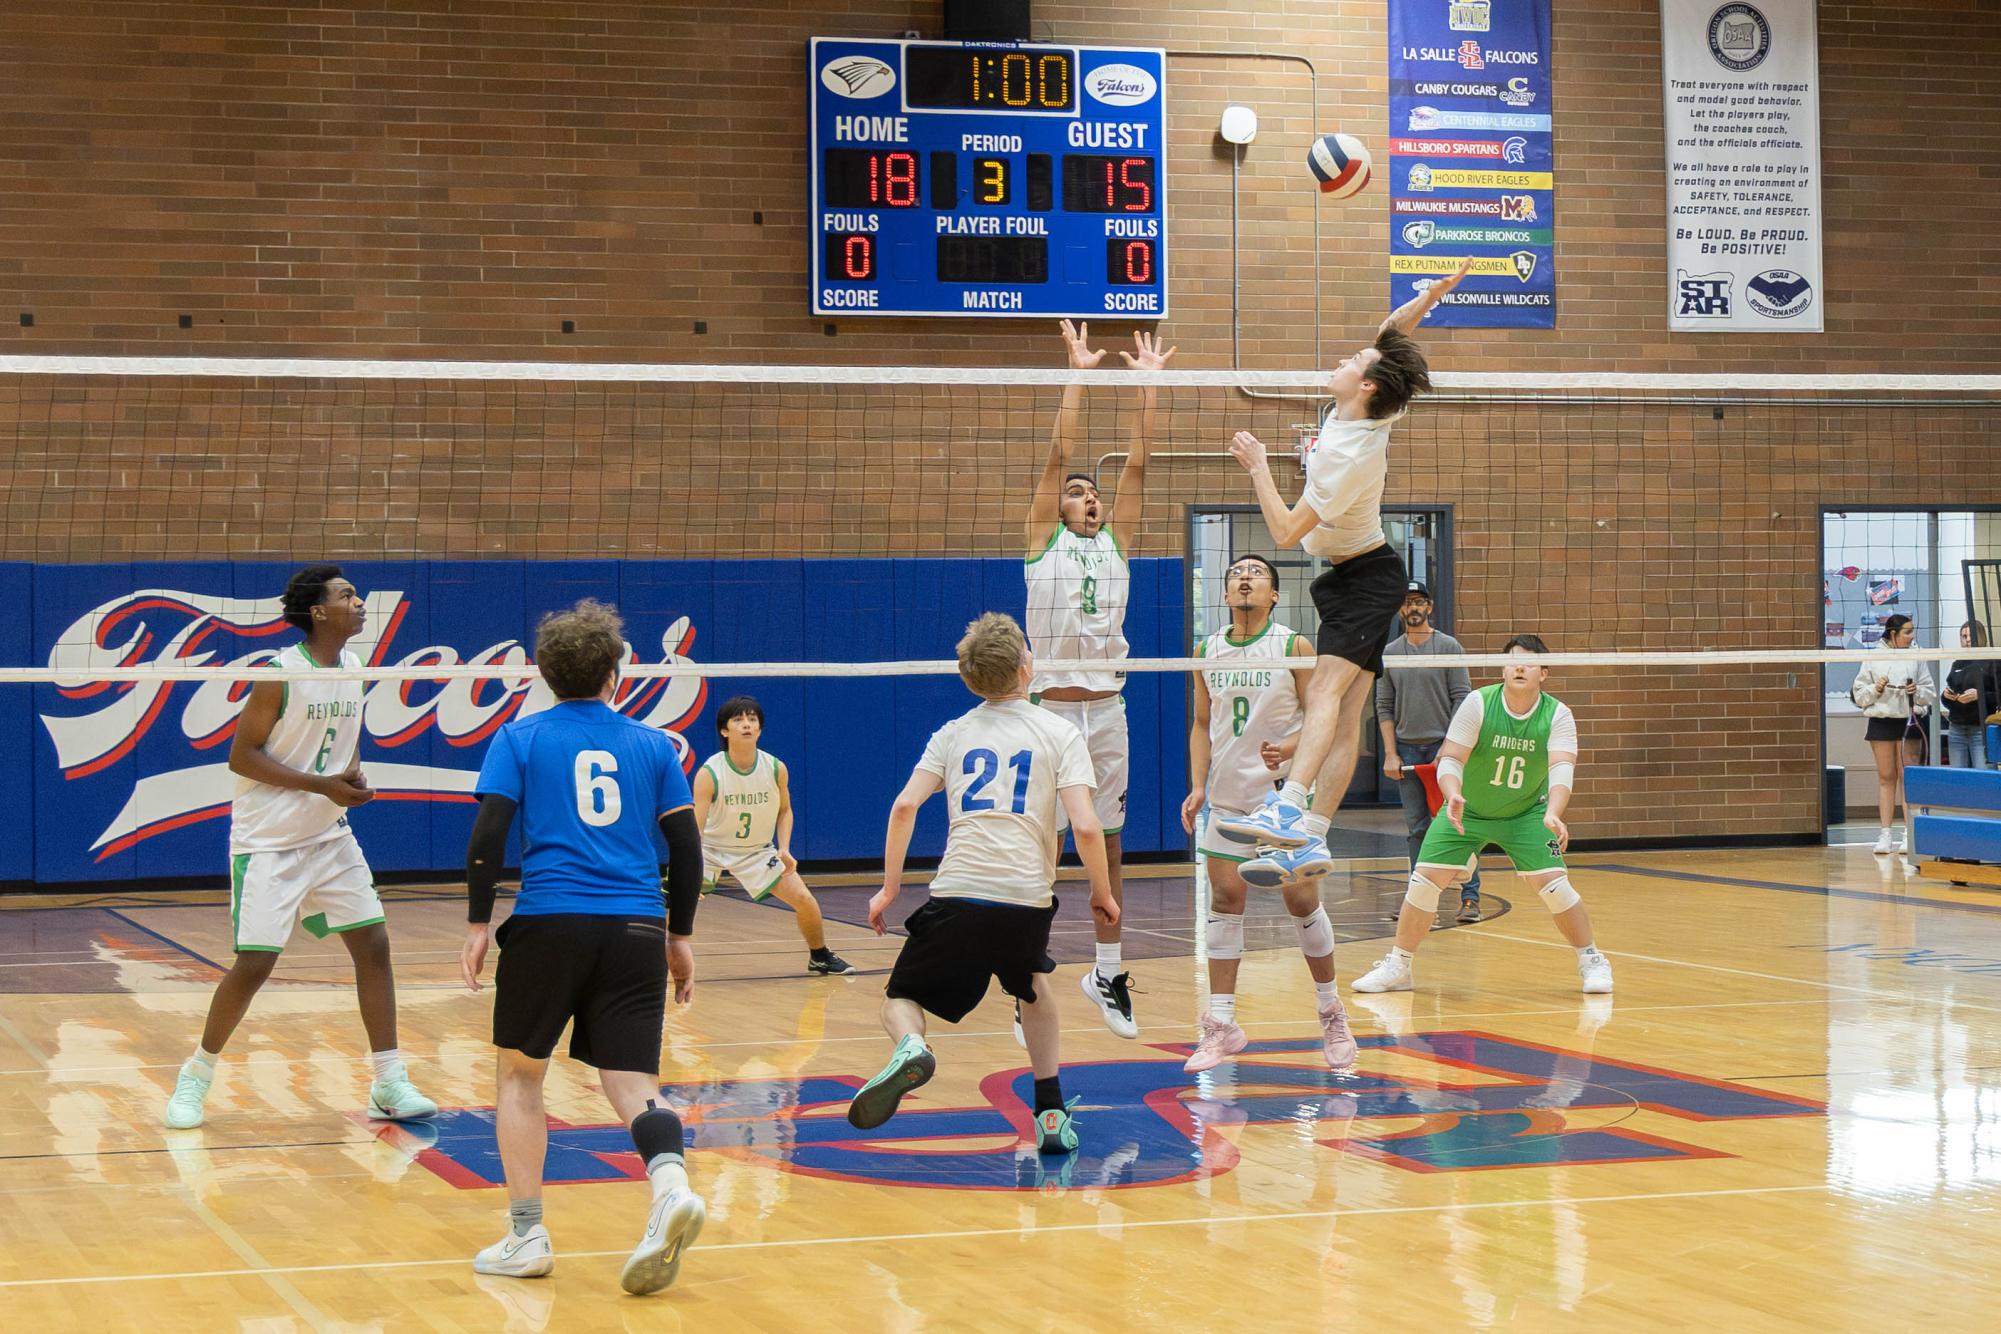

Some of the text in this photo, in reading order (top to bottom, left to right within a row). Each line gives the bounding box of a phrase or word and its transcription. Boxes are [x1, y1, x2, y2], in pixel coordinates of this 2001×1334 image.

[964, 41, 1017, 49] DAKTRONICS
[1403, 47, 1455, 61] LA SALLE
[1486, 50, 1538, 64] FALCONS
[972, 54, 1068, 106] 1:00
[1097, 78, 1145, 93] Falcons
[1671, 80, 1808, 93] Treat everyone with respect
[1415, 83, 1497, 96] CANBY COUGARS
[1677, 95, 1802, 105] and model good behavior.
[1443, 115, 1498, 126] CENTENNIAL
[1501, 117, 1536, 127] EAGLES
[1690, 110, 1705, 118] Let
[1709, 110, 1724, 118] the
[1728, 111, 1764, 120] players
[836, 116, 908, 142] HOME
[1068, 122, 1148, 148] GUEST
[1694, 124, 1787, 134] the coaches coach,
[962, 135, 1022, 152] PERIOD
[1399, 142, 1499, 154] HILLSBORO SPARTANS
[1678, 138, 1803, 148] and the officials officiate.
[1673, 163, 1687, 171] We
[1691, 163, 1703, 171] all
[1742, 164, 1760, 172] role
[1777, 165, 1797, 174] play
[1800, 165, 1808, 173] in
[871, 154, 915, 206] 18
[983, 162, 1003, 201] 3
[1106, 160, 1149, 210] 15
[1468, 176, 1493, 184] RIVER
[1497, 176, 1529, 185] EAGLES
[1675, 177, 1715, 187] creating
[1734, 178, 1795, 187] environment
[1798, 179, 1808, 187] of
[1691, 192, 1793, 202] SAFETY, TOLERANCE,
[1396, 202, 1499, 213] MILWAUKIE MUSTANGS
[1502, 196, 1522, 220] M
[1673, 206, 1810, 216] ACCEPTANCE, and RESPECT.
[824, 214, 879, 232] FOULS
[937, 217, 1048, 235] PLAYER FOUL
[1105, 220, 1158, 237] FOULS
[1436, 230, 1529, 241] PARKROSE BRONCOS
[1677, 229, 1808, 241] Be LOUD. Be PROUD.
[1701, 244, 1786, 254] Be POSITIVE!
[846, 237, 869, 277] 0
[1127, 242, 1149, 282] 0
[1395, 260, 1507, 271] REX PUTNAM KNGSMEN
[823, 289, 878, 307] SCORE
[963, 292, 1022, 309] MATCH
[1105, 293, 1158, 311] SCORE
[1441, 294, 1549, 305] WILSONVILLE WILDCATS
[1750, 299, 1807, 316] SPORTSMANSHIP
[1211, 672, 1271, 687] REYNOLDS
[1233, 697, 1249, 736] 8
[316, 728, 336, 773] 6
[1492, 735, 1535, 752] RAIDERS
[1490, 756, 1525, 789] 16
[575, 750, 622, 826] 6
[962, 748, 1032, 814] 21
[725, 792, 768, 805] REYNOLDS
[736, 812, 751, 838] 3
